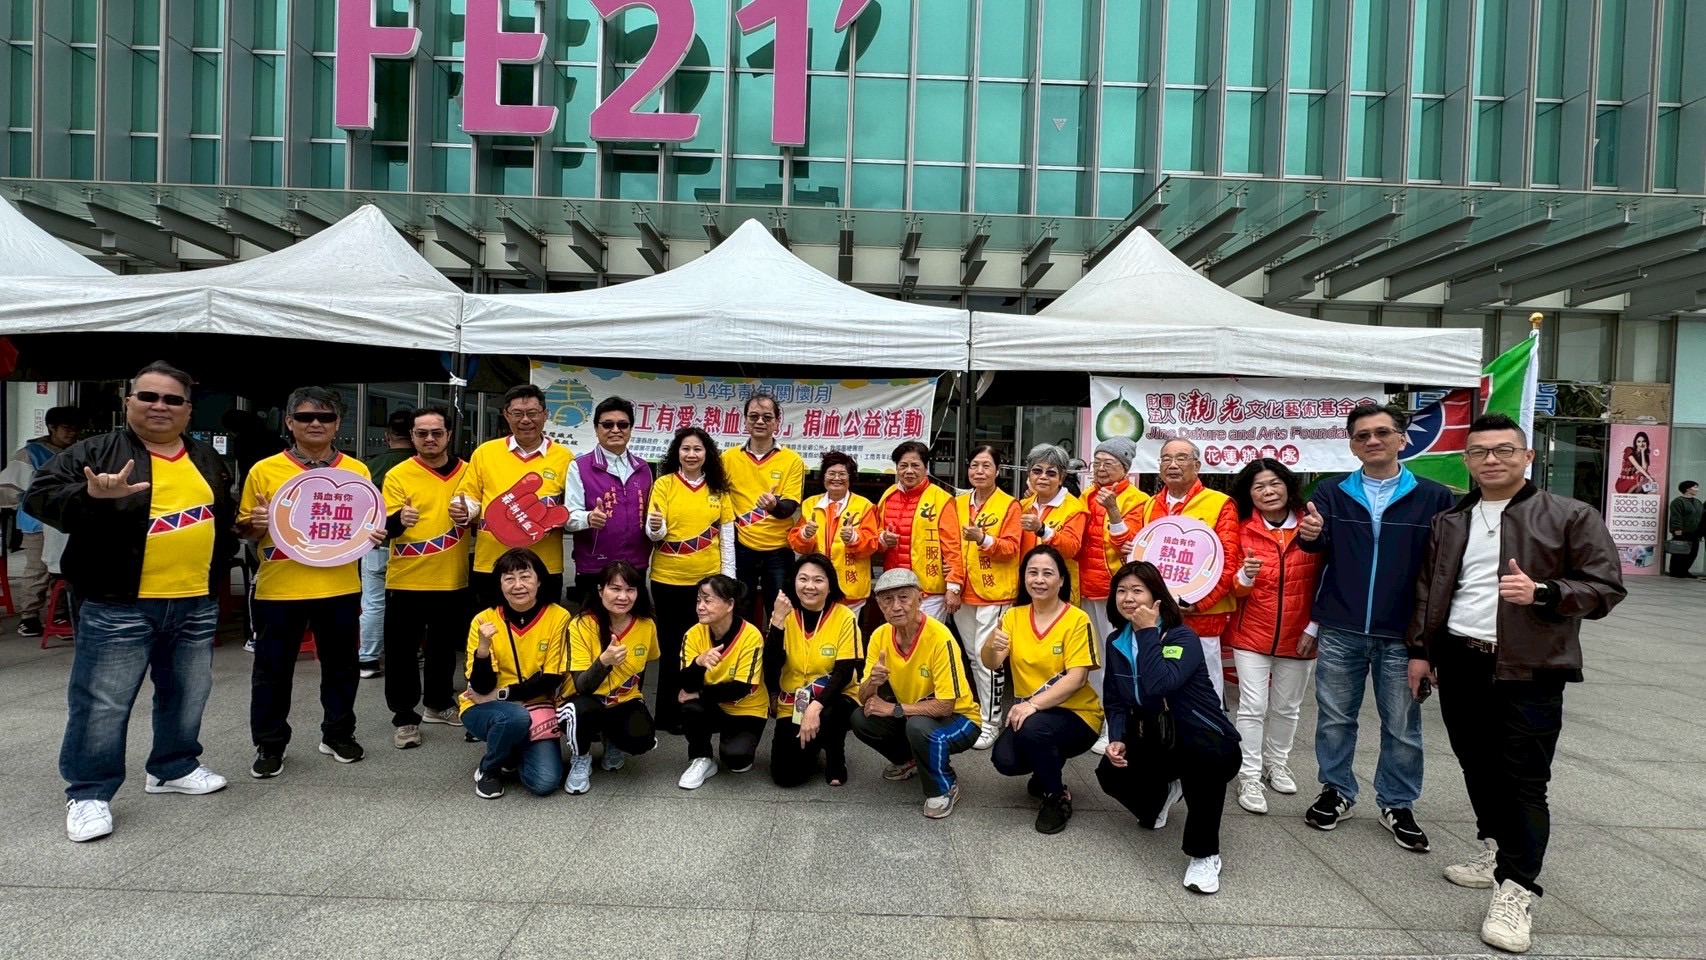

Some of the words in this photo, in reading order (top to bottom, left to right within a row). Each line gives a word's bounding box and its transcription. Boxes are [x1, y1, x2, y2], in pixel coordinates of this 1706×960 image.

[684, 382, 832, 403] 114年青年關懷月
[1146, 394, 1176, 410] 財團
[1148, 408, 1177, 424] 法人
[1228, 426, 1256, 440] and
[1257, 426, 1288, 440] Arts
[1204, 444, 1299, 465] 花蓮辦事處
[313, 491, 353, 502] 捐血有你
[310, 502, 353, 520] 熱血
[308, 521, 351, 540] 相挺
[1163, 536, 1196, 548] 捐血有你
[925, 528, 939, 577] 工服隊
[1159, 545, 1194, 565] 熱血
[1157, 562, 1192, 583] 相挺
